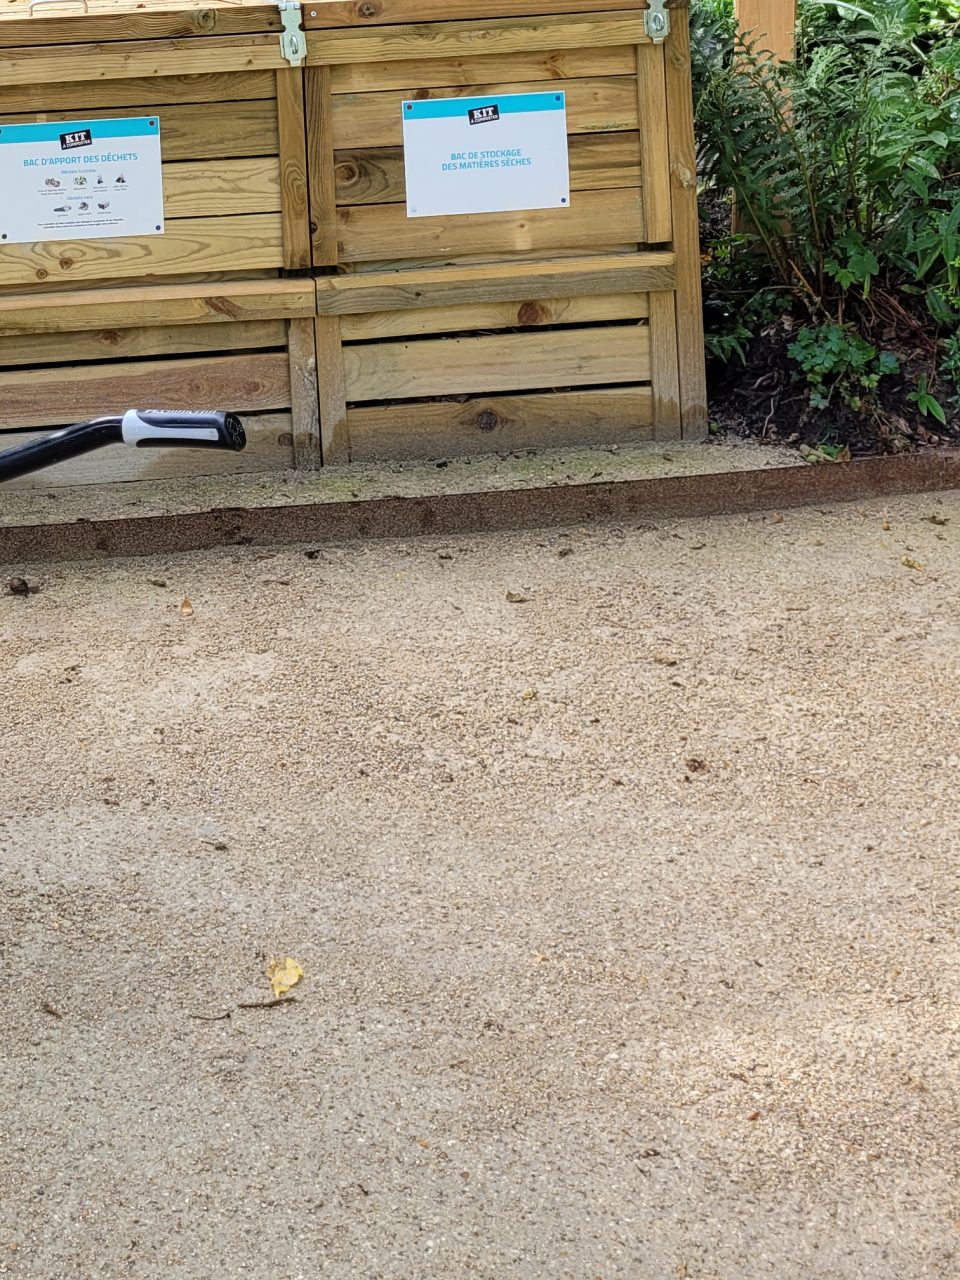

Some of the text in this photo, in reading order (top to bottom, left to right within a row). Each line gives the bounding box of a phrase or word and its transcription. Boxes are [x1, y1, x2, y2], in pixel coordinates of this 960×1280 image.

[472, 107, 494, 119] KIT
[64, 131, 87, 144] KIT
[23, 152, 138, 167] BAC D'APPORT DES DÉCHETS
[450, 149, 522, 161] BAC DE STOCKAGE
[442, 157, 532, 171] DES MATIÈRES SÈCHES
